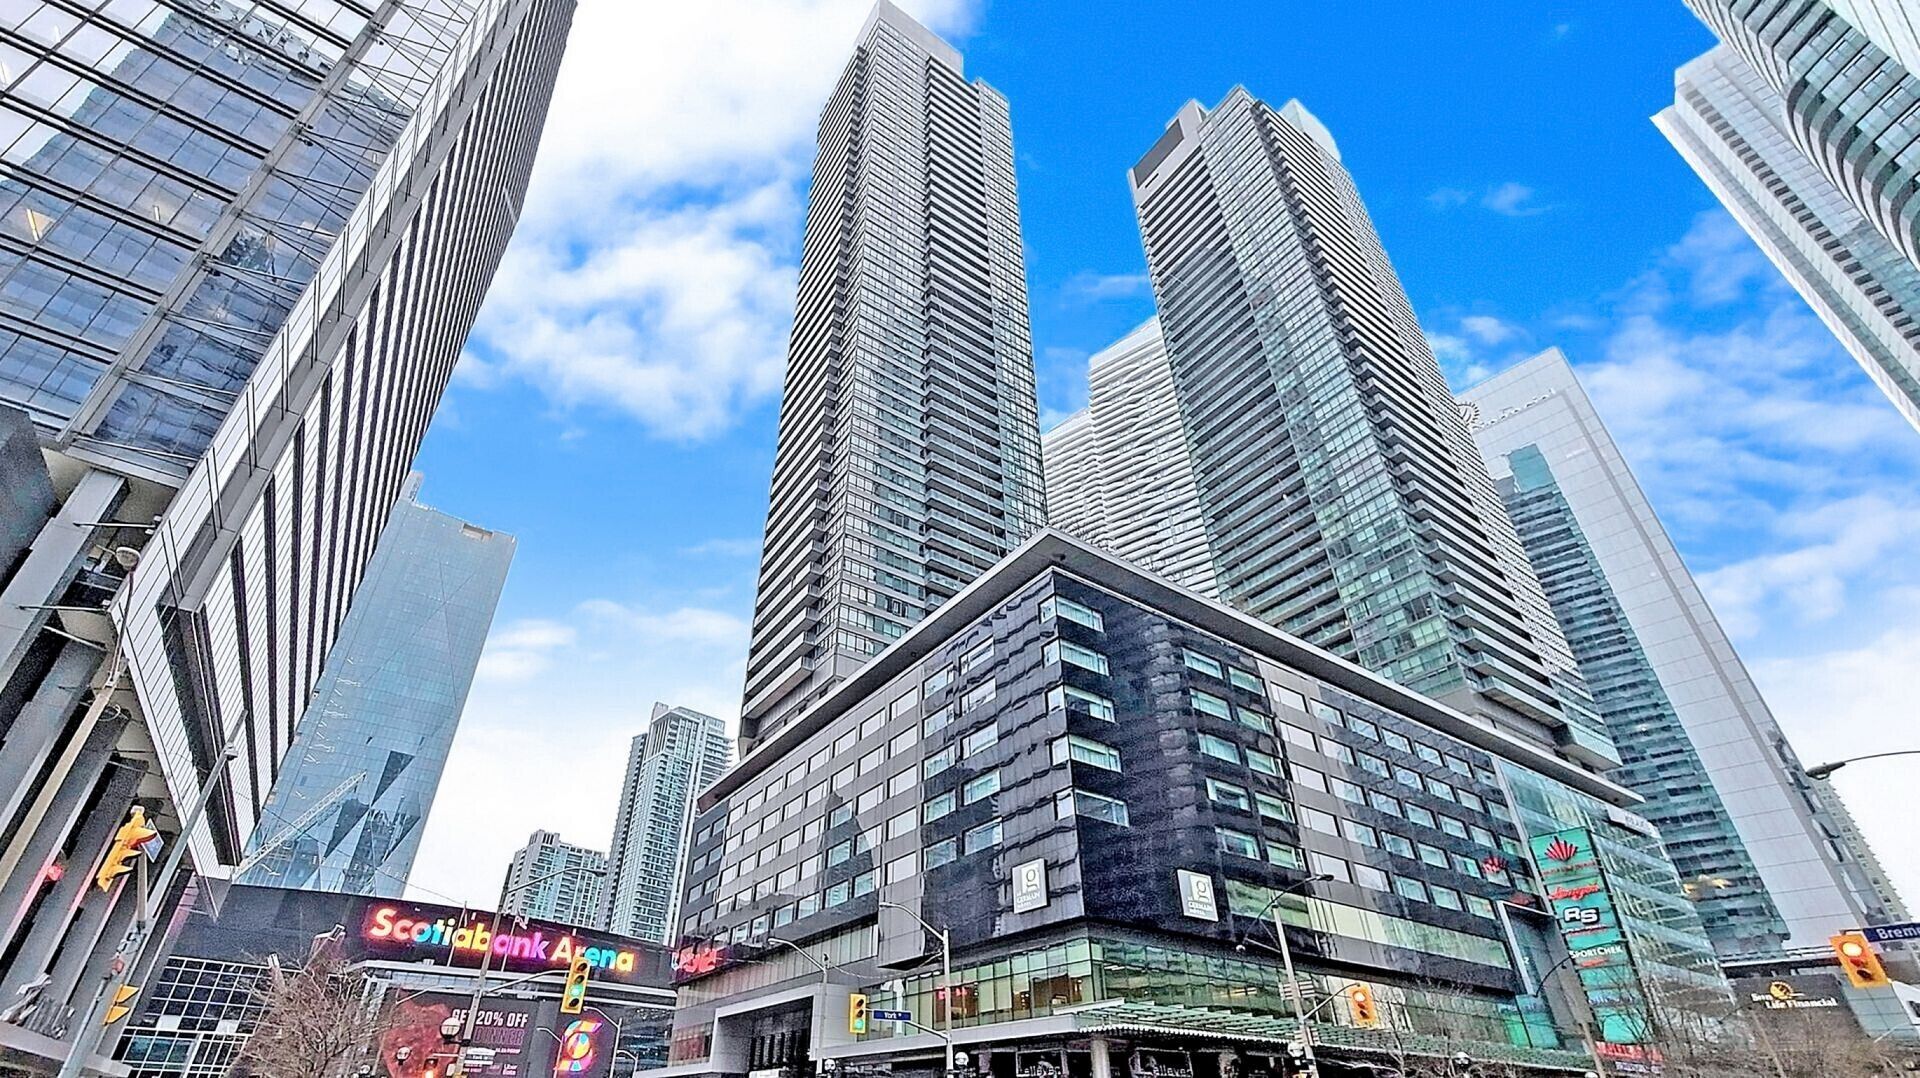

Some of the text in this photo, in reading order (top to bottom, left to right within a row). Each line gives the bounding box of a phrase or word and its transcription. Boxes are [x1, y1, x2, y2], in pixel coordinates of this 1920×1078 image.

[370, 907, 549, 961] Scotiabank
[550, 935, 636, 972] Arena
[1765, 996, 1838, 1009] Life Financial
[476, 1010, 504, 1027] 20%
[506, 1012, 529, 1028] OFF
[884, 1011, 897, 1019] York
